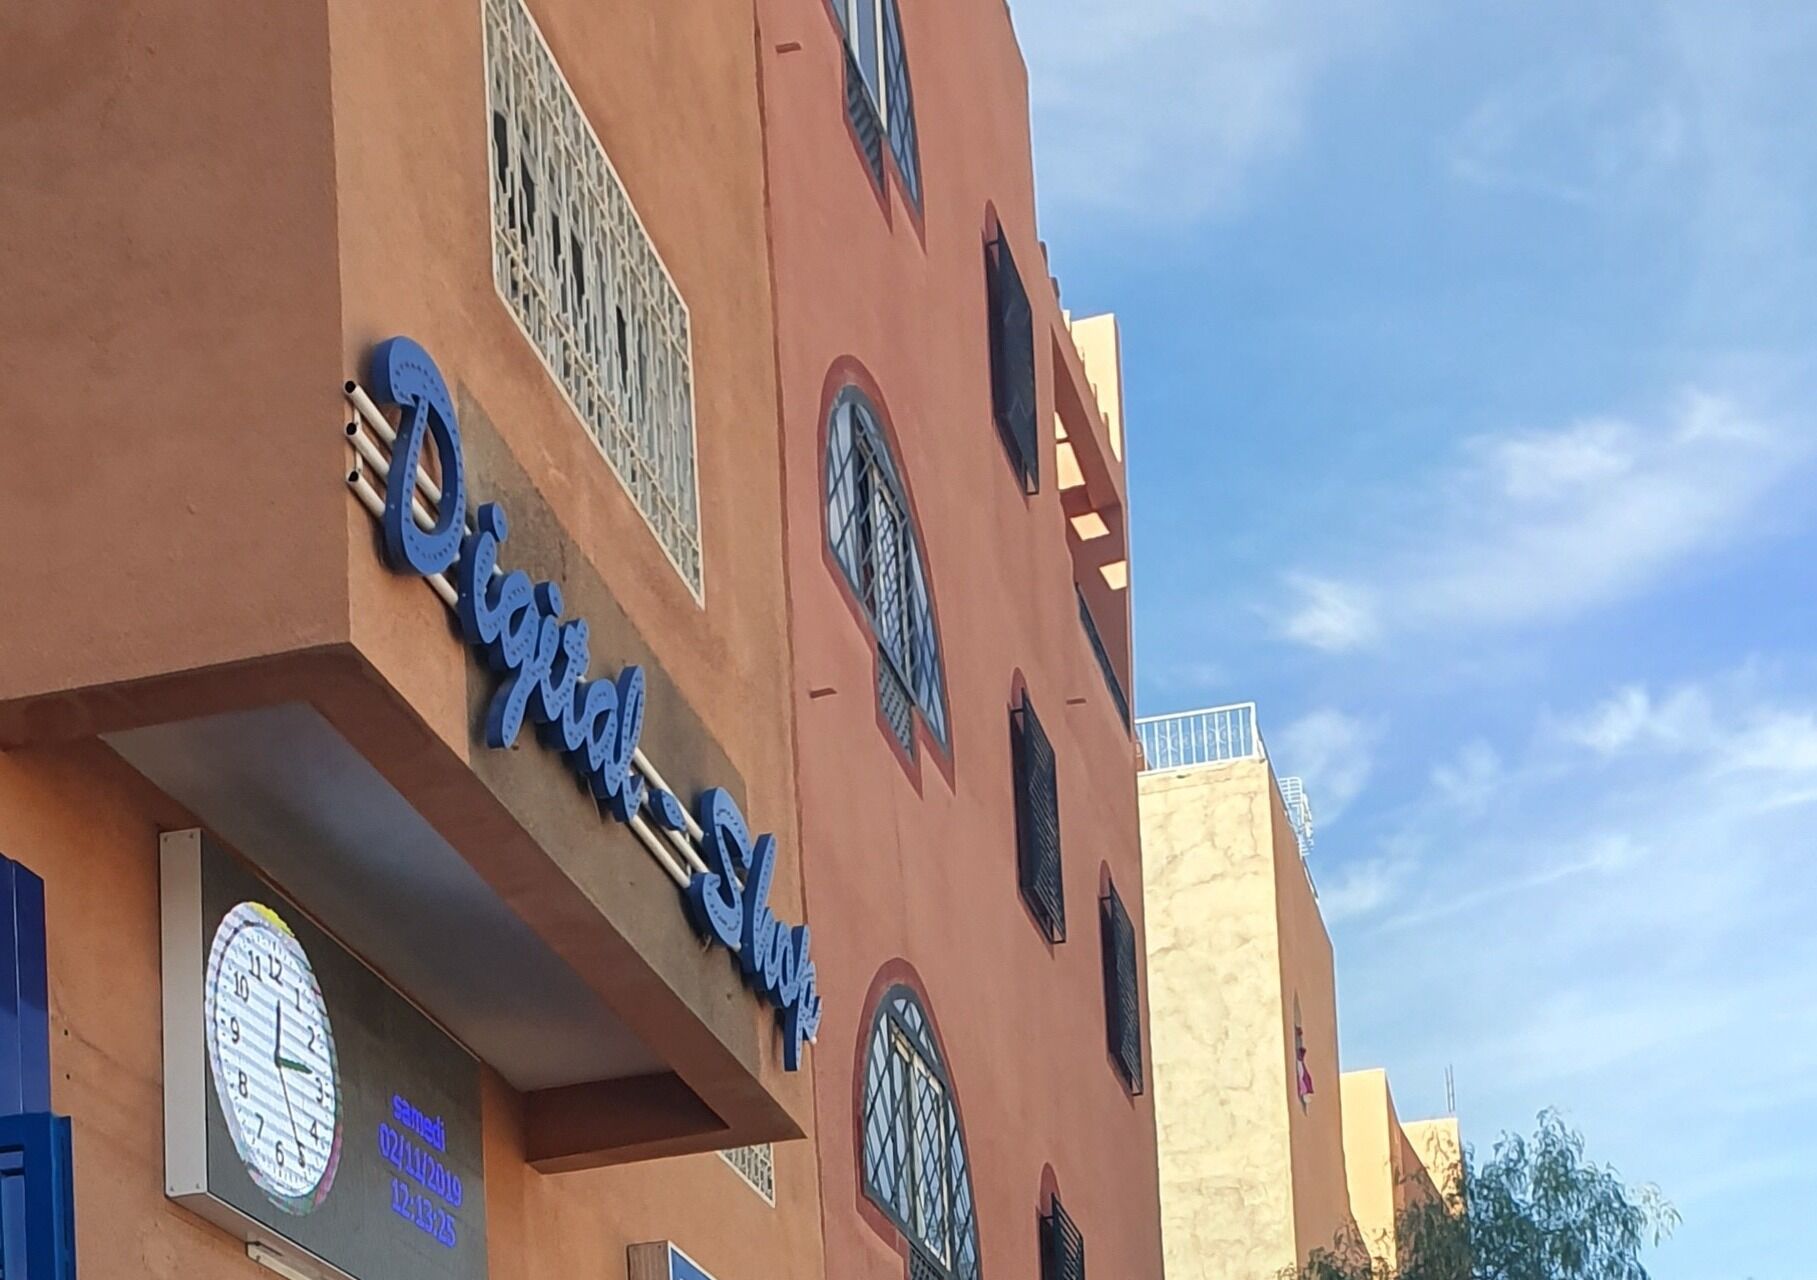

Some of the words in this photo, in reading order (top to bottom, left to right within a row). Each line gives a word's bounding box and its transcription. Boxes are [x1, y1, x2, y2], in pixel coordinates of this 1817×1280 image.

[372, 335, 645, 823] Digital
[689, 786, 823, 1071] Shop
[248, 951, 262, 982] 11
[268, 954, 284, 986] 12
[233, 972, 250, 1004] 10
[294, 988, 301, 1011] 1
[230, 1017, 240, 1044] 9
[308, 1026, 316, 1051] 2
[239, 1071, 249, 1098] 8
[315, 1077, 326, 1104] 3
[255, 1112, 265, 1140] 7
[310, 1120, 320, 1146] 4
[392, 1094, 446, 1152] samedi
[275, 1140, 285, 1166] 6
[379, 1123, 462, 1208] 02/11/2019
[392, 1177, 456, 1248] 12:13:25
